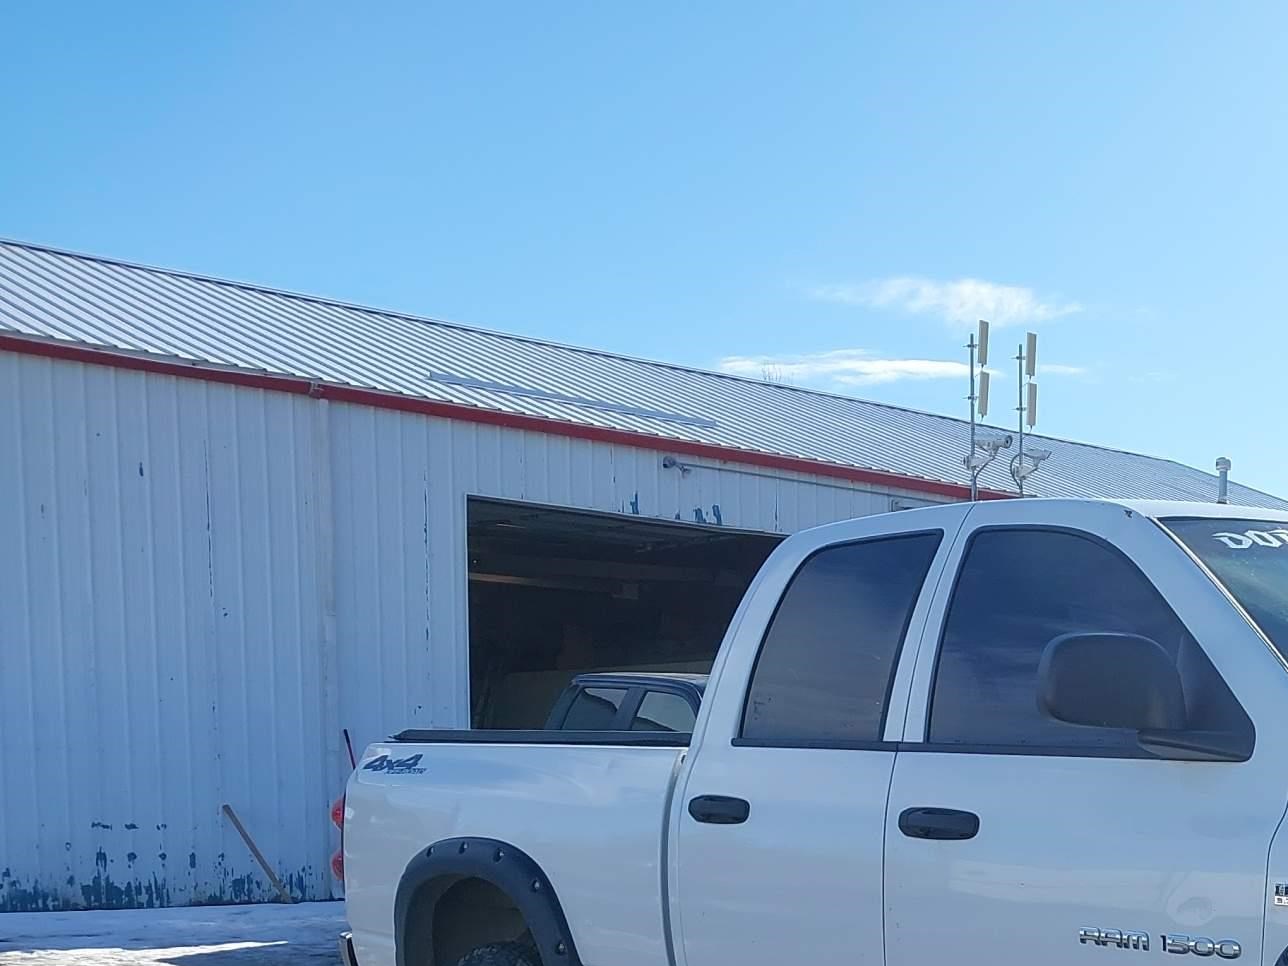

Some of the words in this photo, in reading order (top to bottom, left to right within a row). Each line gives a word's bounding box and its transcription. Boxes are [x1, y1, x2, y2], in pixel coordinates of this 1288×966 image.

[362, 753, 424, 772] 4x4
[1079, 927, 1150, 951] RAM
[1160, 934, 1242, 959] 1500
